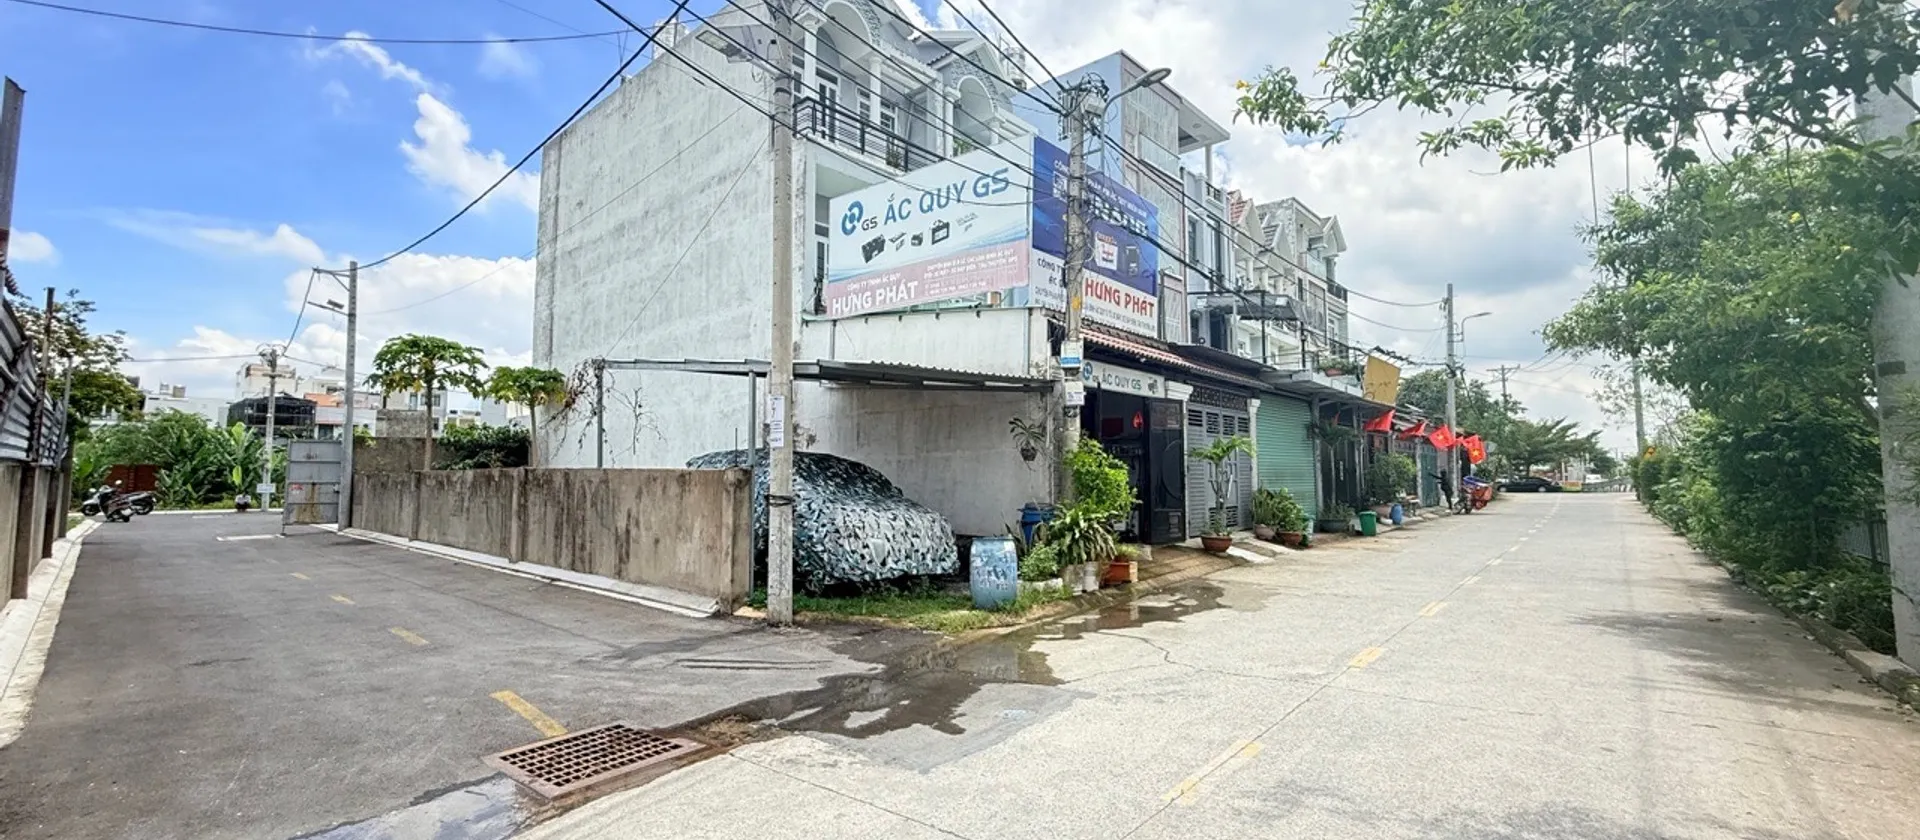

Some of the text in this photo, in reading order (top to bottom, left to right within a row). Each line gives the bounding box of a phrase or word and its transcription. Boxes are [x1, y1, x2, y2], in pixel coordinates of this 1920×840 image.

[861, 168, 1009, 231] GS ẮC QUY GS
[832, 291, 872, 316] HƯNG
[875, 279, 918, 305] PHÁT
[1085, 277, 1120, 307] HƯNG
[1125, 293, 1155, 318] PHÁT
[1131, 379, 1142, 390] GS
